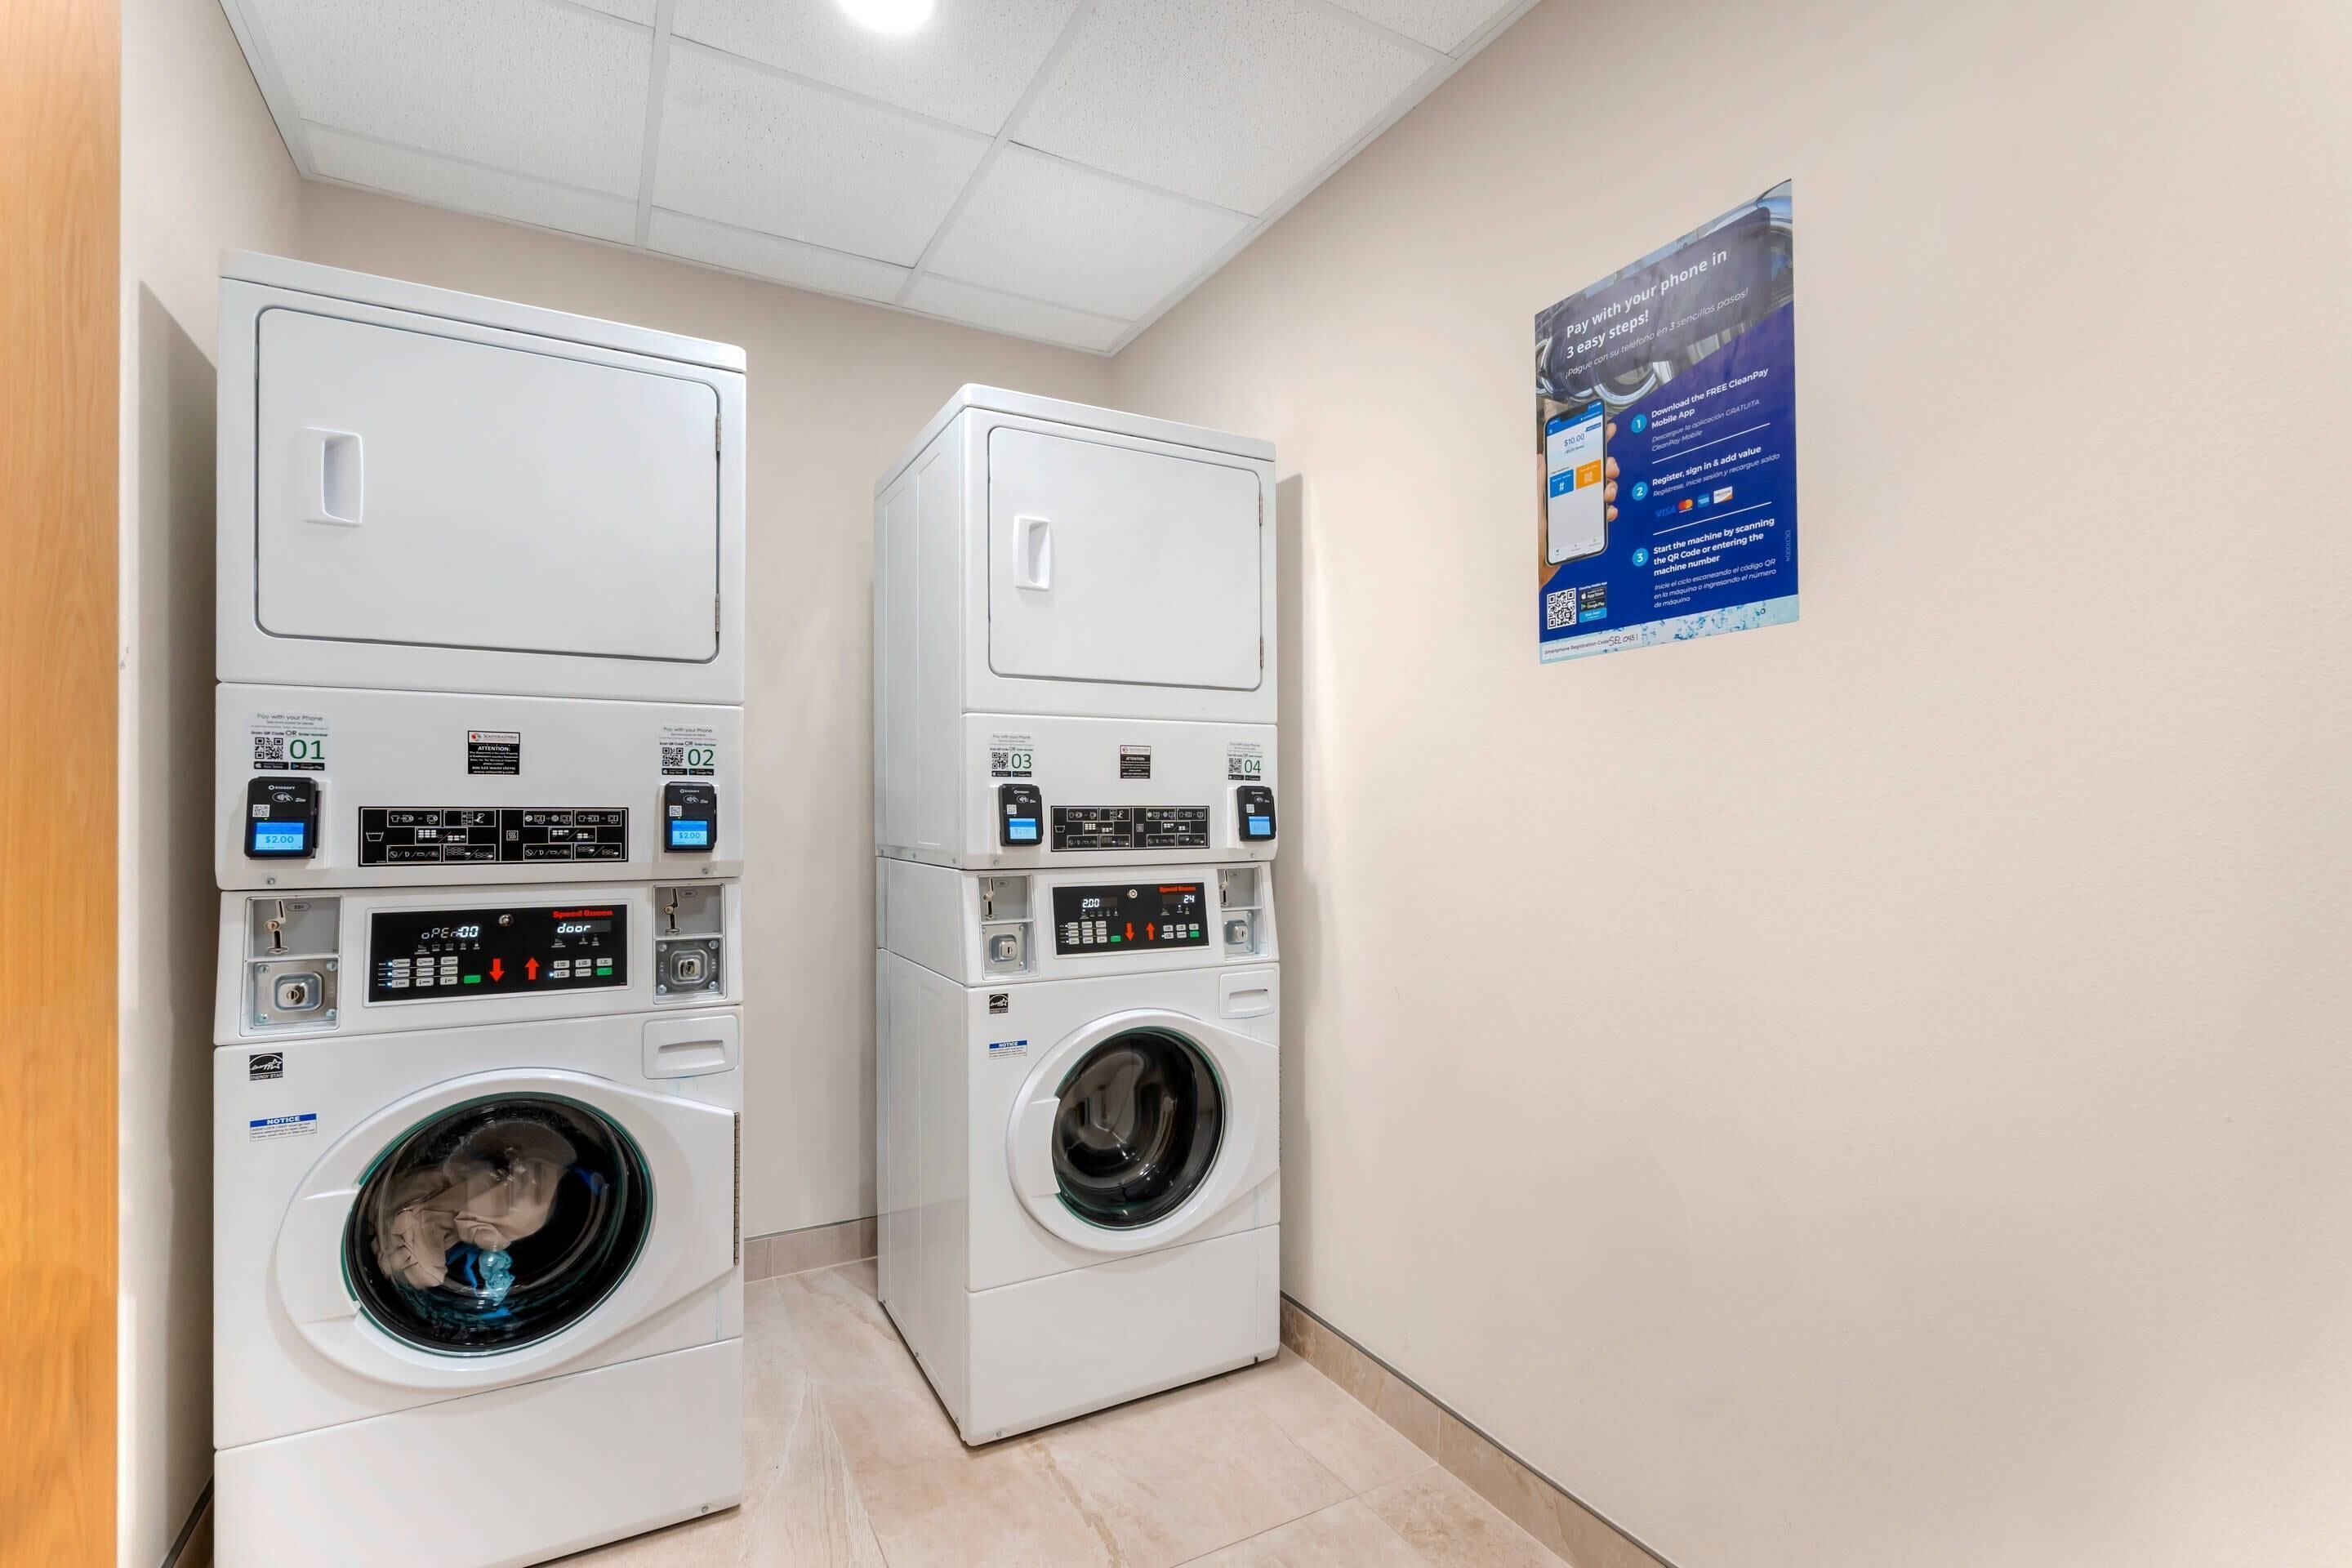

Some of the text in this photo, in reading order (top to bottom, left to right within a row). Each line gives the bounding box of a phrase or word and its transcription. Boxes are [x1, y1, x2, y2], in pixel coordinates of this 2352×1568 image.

[1566, 250, 1727, 338] Pay with your phone in
[1566, 310, 1649, 359] 3 easy steps!
[1593, 354, 1608, 365] con
[1610, 349, 1619, 359] su
[1621, 332, 1655, 353] teléfono
[1656, 327, 1668, 336] en
[1669, 321, 1675, 331] 3
[1677, 304, 1715, 327] sencillos
[1717, 287, 1748, 310] pasos!
[1651, 368, 1769, 418] Download the FREE CleanPay
[1636, 419, 1642, 429] 1
[1651, 408, 1695, 430] Mobile App
[1652, 399, 1760, 443] Descargue la aplicación GRATUITA
[1652, 430, 1703, 452] CleanPay Mobile
[1652, 446, 1762, 487] Register, sign in & add value
[1686, 476, 1702, 487] inicie
[1703, 470, 1723, 482] sesión
[1723, 469, 1729, 478] y
[1729, 460, 1760, 474] recargue
[1761, 452, 1780, 465] saldo
[1637, 487, 1643, 497] 2
[1655, 505, 1677, 518] VISA
[1653, 518, 1775, 555] Start the machine by scanning
[1654, 532, 1764, 565] the QR Code or entering the
[1637, 553, 1643, 562] 3
[1654, 555, 1721, 577] machine number
[1655, 581, 1670, 590] Inicie
[1671, 578, 1677, 586] el
[1677, 576, 1692, 586] ciclo
[1692, 569, 1731, 582] escaneando
[1740, 561, 1764, 573] código
[1765, 558, 1776, 567] QR
[1662, 590, 1668, 598] la
[1668, 585, 1697, 598] máquina
[1703, 576, 1740, 590] ingresando
[1748, 568, 1777, 580] número
[1654, 596, 1690, 608] de máquina
[1544, 646, 1570, 655] Smartphone
[1570, 641, 1597, 651] Registration
[1608, 635, 1622, 647] SEL
[289, 739, 325, 760] 01
[688, 749, 714, 766] 02
[1011, 753, 1032, 769] 03
[1244, 759, 1262, 774] 04
[265, 835, 294, 844] $2.00
[1082, 898, 1100, 908] 2.00
[1183, 894, 1195, 904] 24
[553, 910, 582, 919] Speed
[557, 923, 591, 933] door
[267, 1116, 301, 1125] NOTICE
